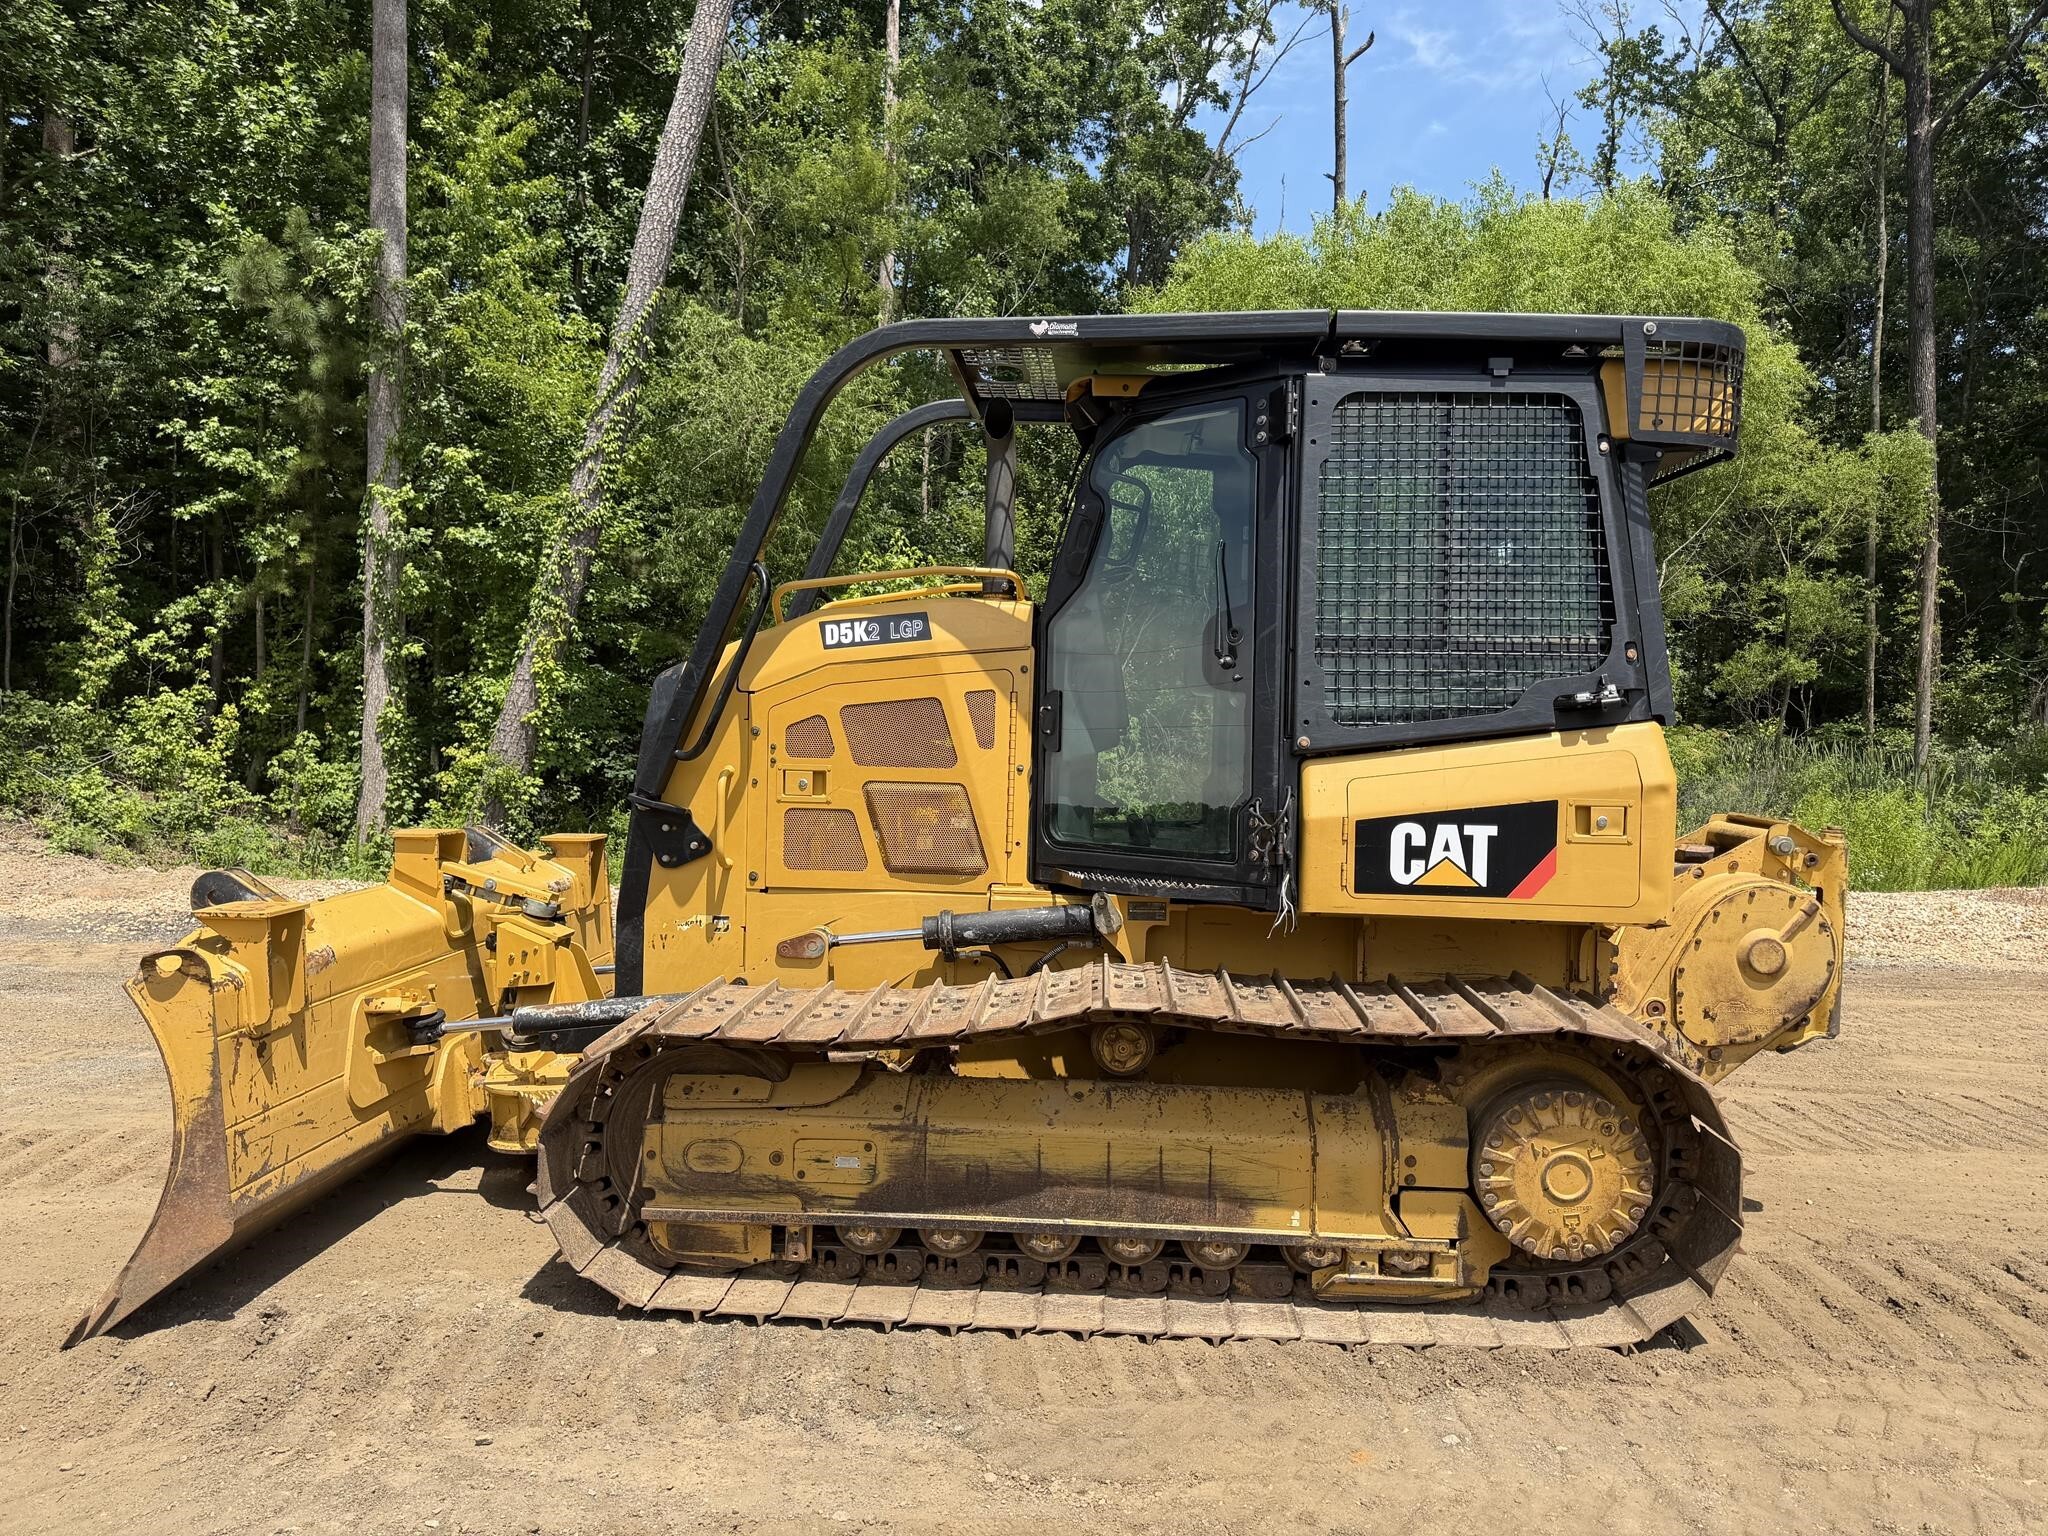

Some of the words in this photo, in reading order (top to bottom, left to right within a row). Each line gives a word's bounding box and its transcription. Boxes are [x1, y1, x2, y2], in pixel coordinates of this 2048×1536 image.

[825, 620, 880, 645] D5K2
[890, 620, 923, 639] LGP
[1389, 822, 1498, 888] CAT
